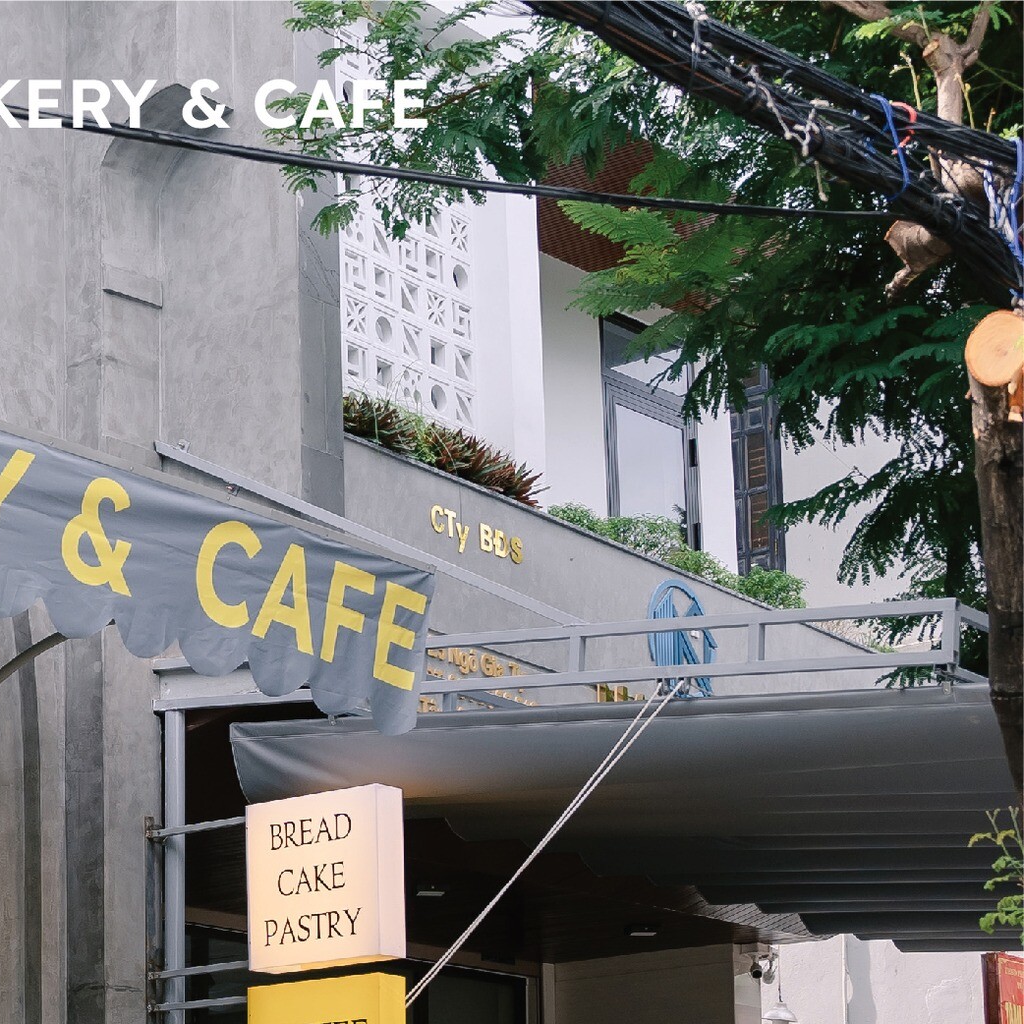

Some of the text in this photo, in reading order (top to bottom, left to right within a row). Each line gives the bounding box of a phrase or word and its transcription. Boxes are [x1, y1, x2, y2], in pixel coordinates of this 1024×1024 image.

[61, 477, 132, 598] &
[195, 520, 429, 692] CAFE
[270, 812, 353, 851] BREAD
[277, 861, 346, 896] CAKE
[264, 907, 362, 947] PASTRY
